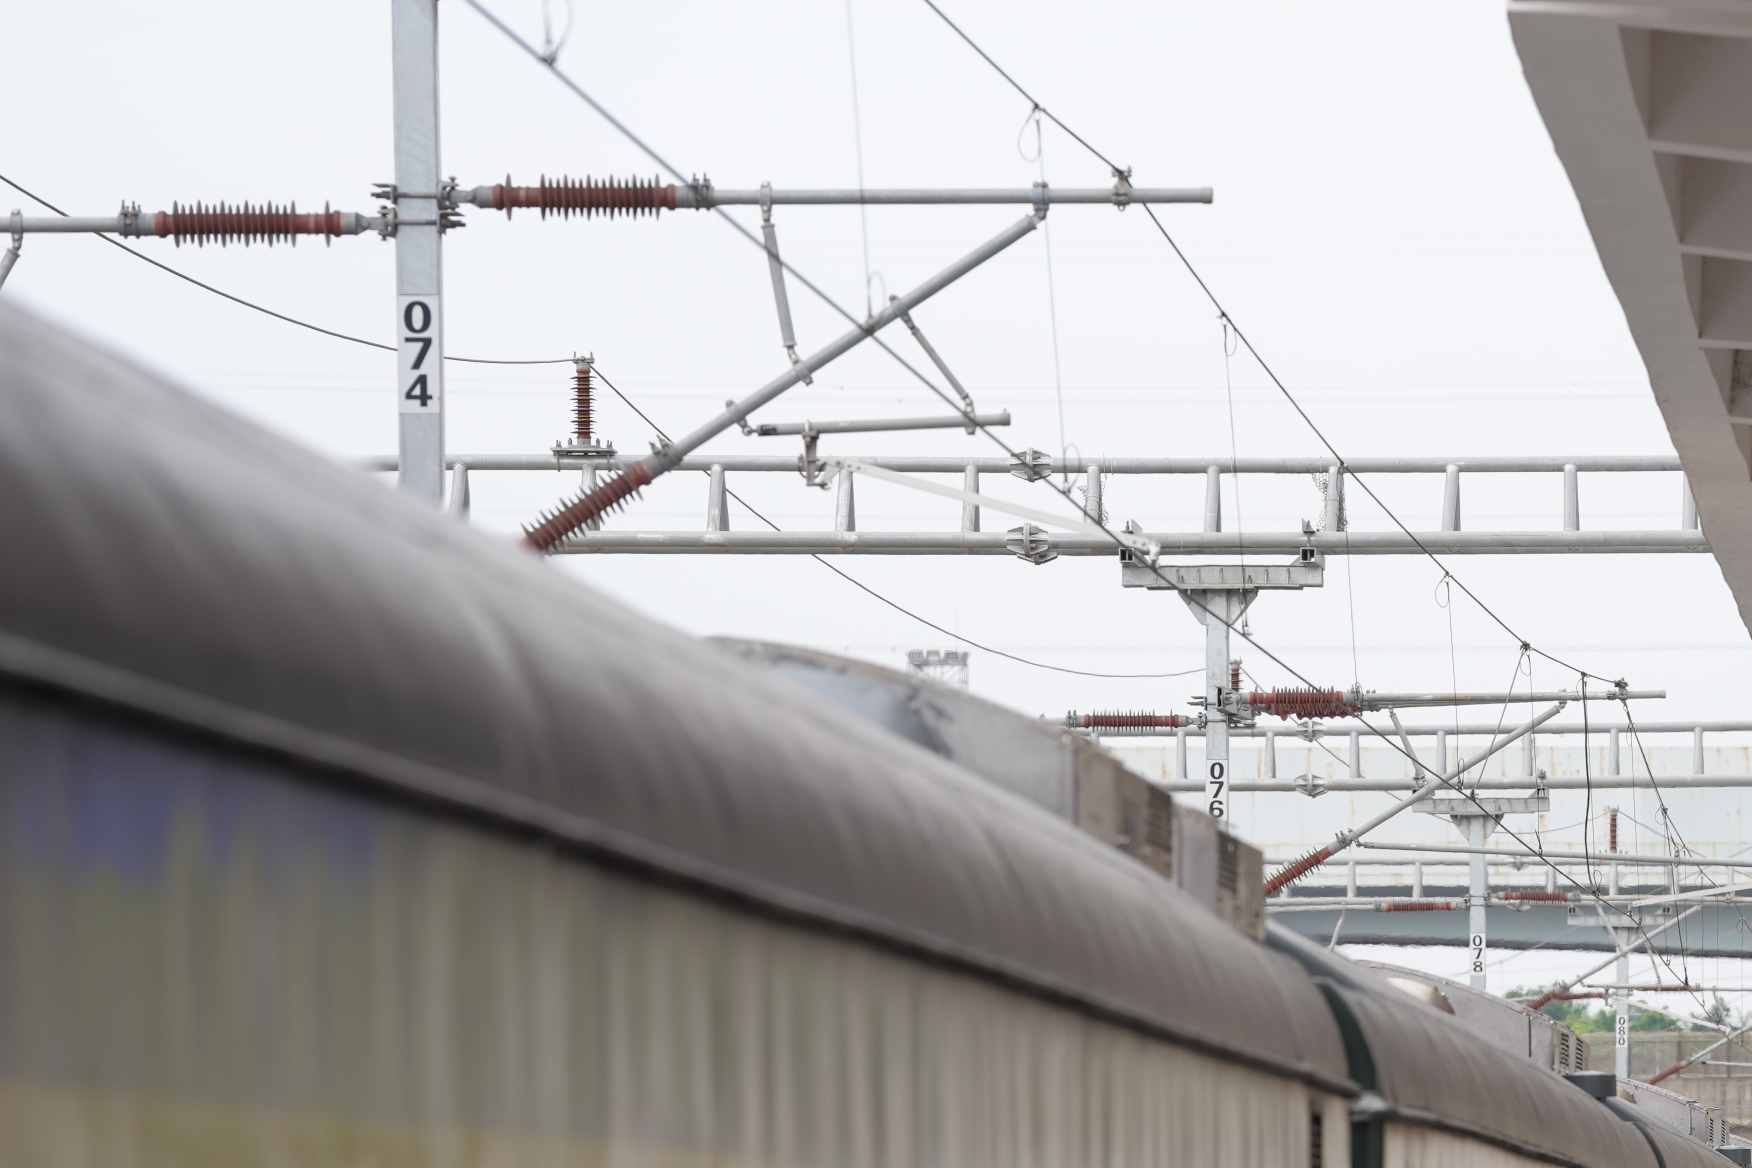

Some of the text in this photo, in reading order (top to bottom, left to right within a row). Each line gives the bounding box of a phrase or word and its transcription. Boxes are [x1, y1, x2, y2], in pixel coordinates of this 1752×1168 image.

[403, 300, 433, 408] 074
[1208, 761, 1225, 818] 076
[1472, 934, 1483, 973] 078
[1618, 1016, 1626, 1046] 080
